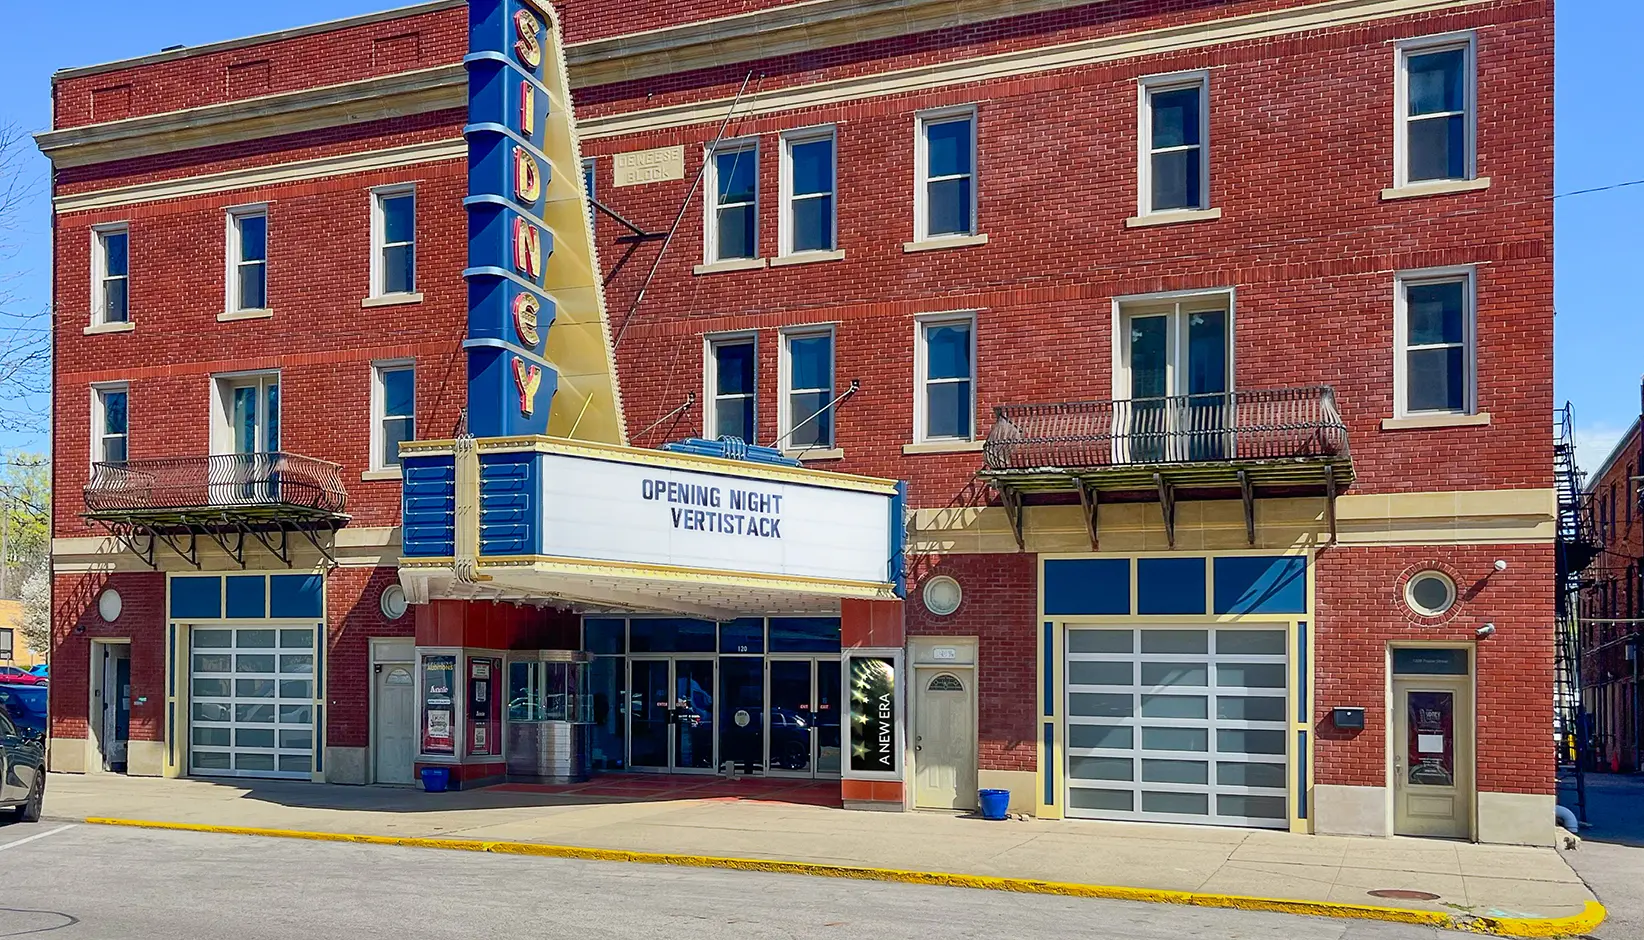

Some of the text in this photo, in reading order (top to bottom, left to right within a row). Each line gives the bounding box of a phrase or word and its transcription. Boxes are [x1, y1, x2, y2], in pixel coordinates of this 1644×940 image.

[514, 10, 543, 416] SIDNEY
[642, 478, 783, 514] OPENING NIGHT
[670, 507, 781, 538] VERTISTACK
[878, 693, 891, 765] A NEW ERA
